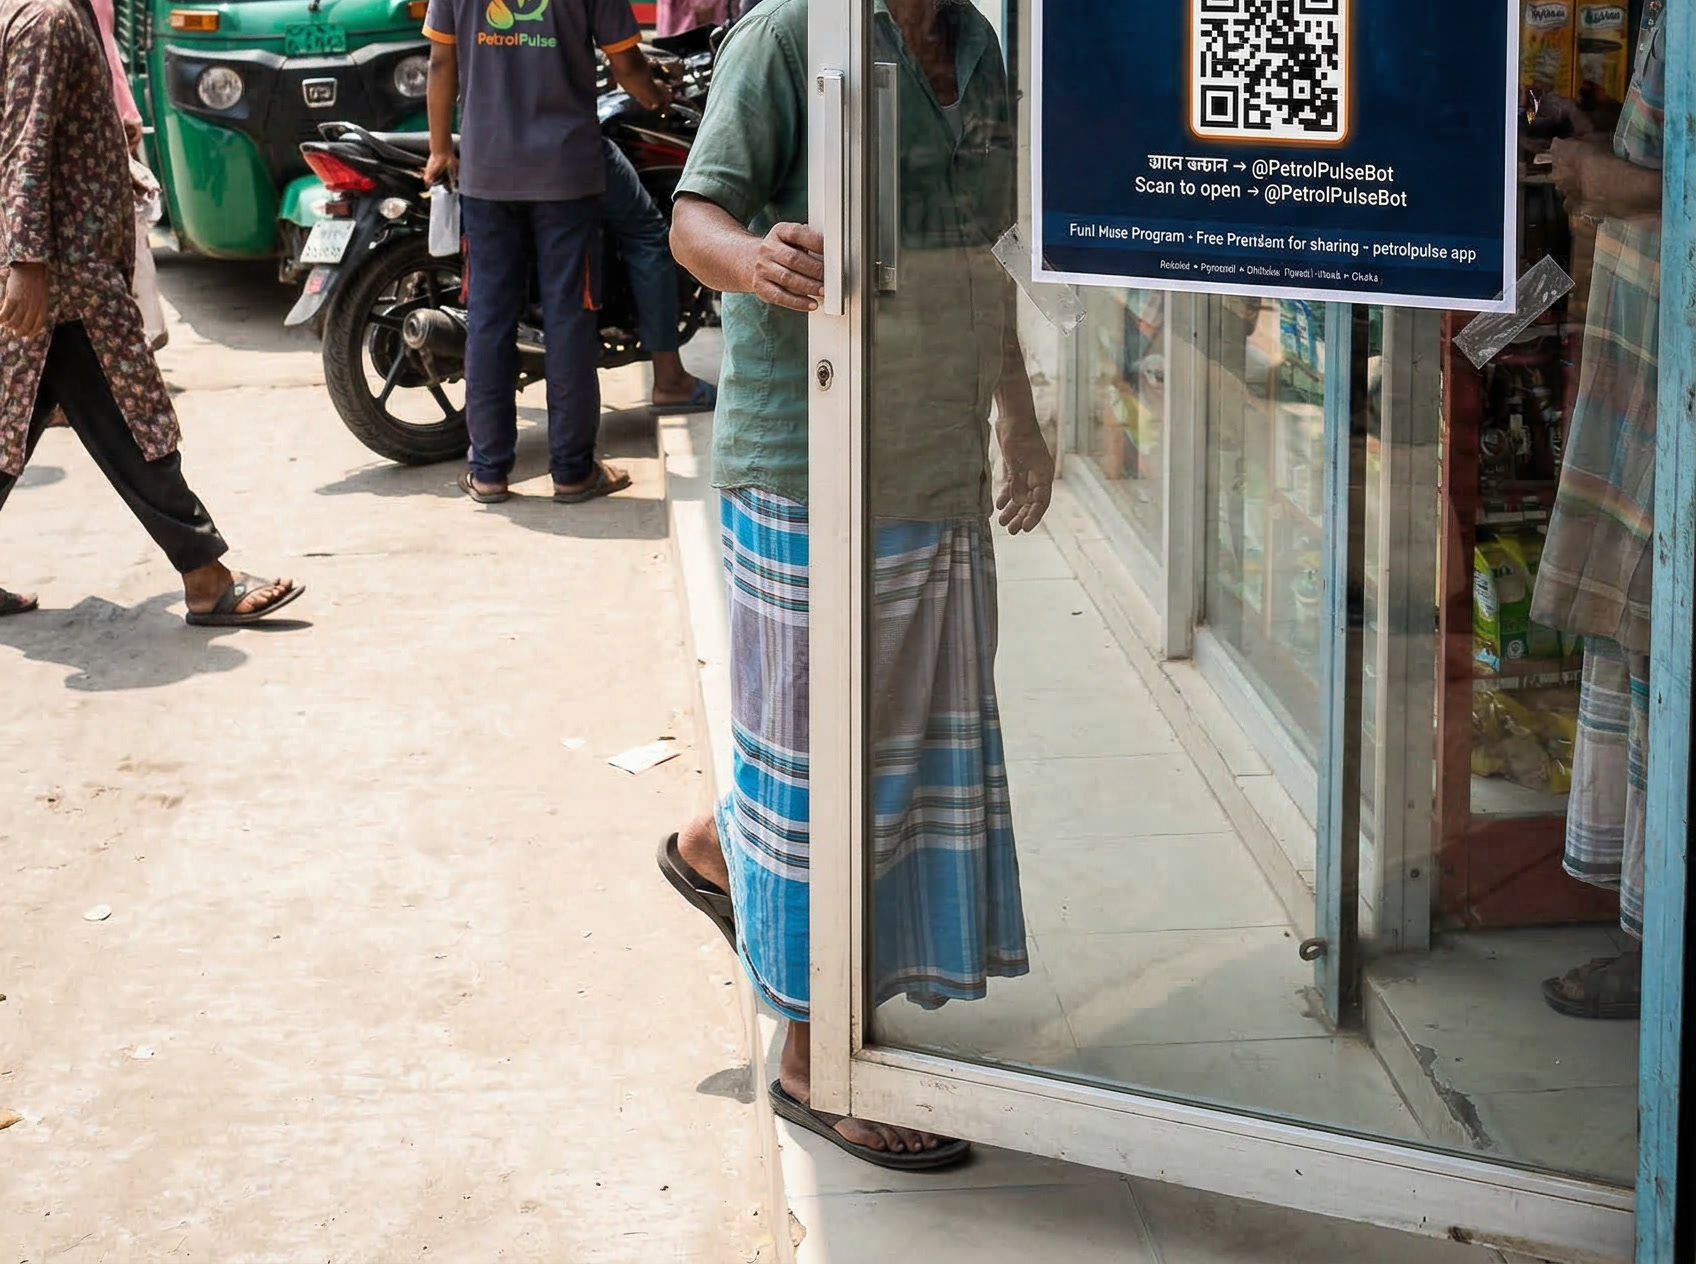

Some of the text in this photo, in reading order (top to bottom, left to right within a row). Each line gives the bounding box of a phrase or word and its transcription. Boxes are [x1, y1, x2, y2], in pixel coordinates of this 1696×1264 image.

[1251, 159, 1394, 183] @PetrolPulseBot
[1134, 176, 1407, 208] Scan to open @PetrolPulseBot
[1131, 226, 1185, 245] Program
[1196, 230, 1224, 246] Free
[1287, 235, 1307, 251] for
[1309, 237, 1360, 257] sharing
[1372, 242, 1448, 260] petrolpulse
[1450, 247, 1478, 264] app
